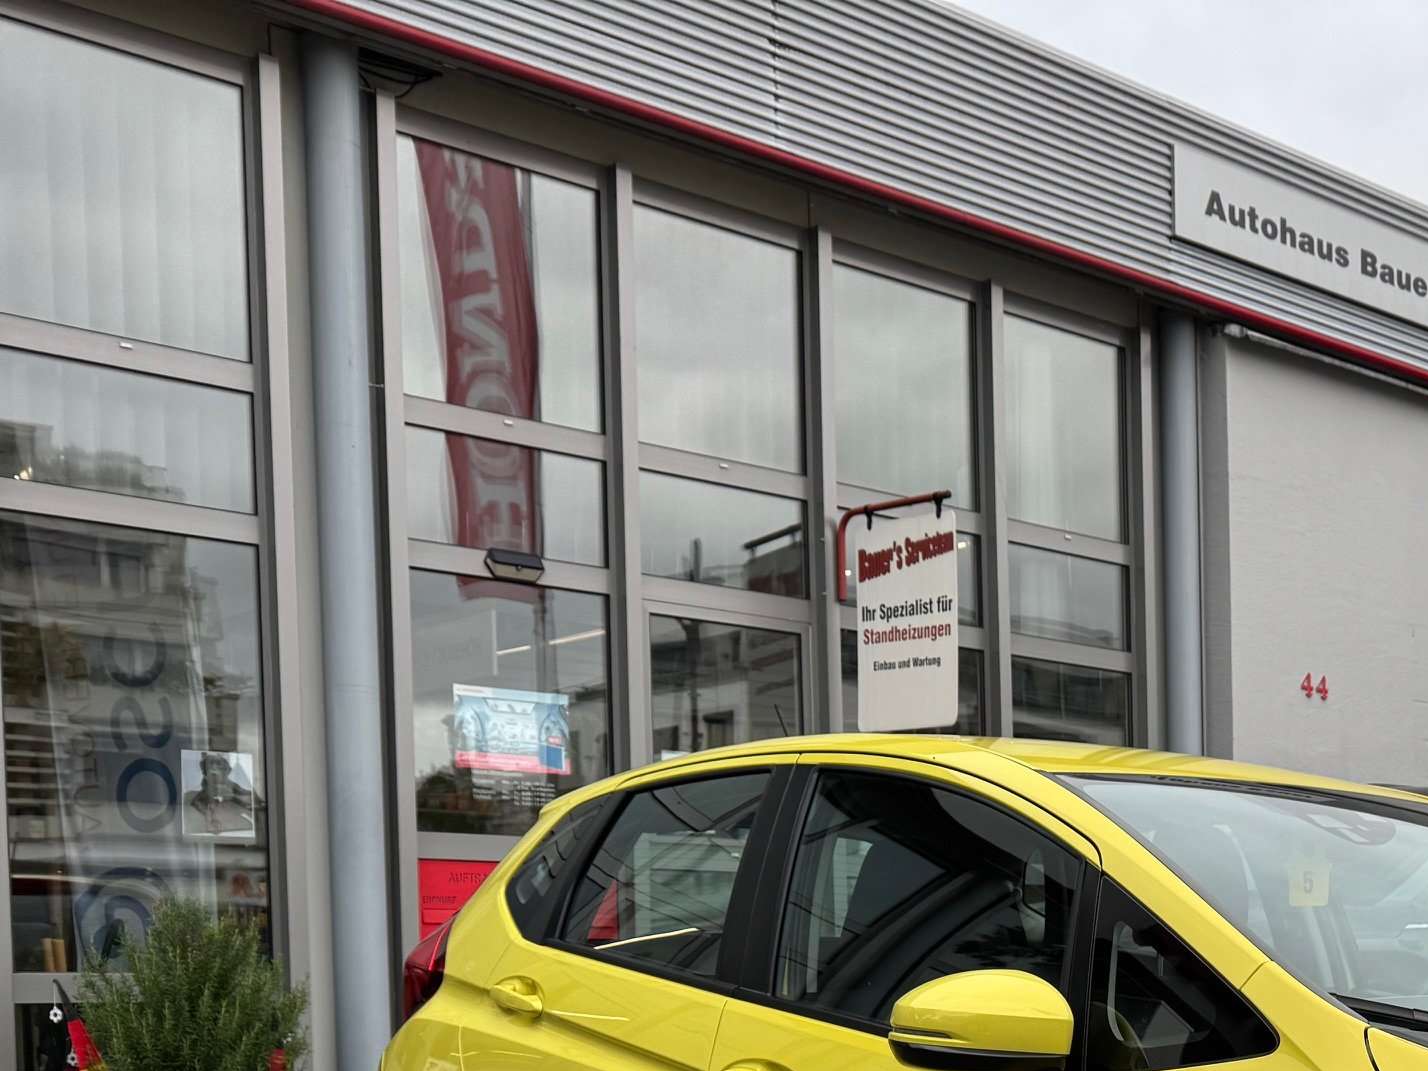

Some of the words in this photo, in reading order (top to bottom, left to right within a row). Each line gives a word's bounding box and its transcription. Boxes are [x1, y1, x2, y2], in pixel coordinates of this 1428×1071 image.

[1204, 190, 1350, 268] Autohaus
[857, 541, 903, 583] Bauer's
[862, 606, 876, 622] Ihr
[879, 597, 934, 623] Spezialist
[937, 595, 953, 613] für
[863, 623, 951, 645] Standheizungen
[873, 661, 897, 672] Einbau
[898, 659, 911, 670] und
[912, 656, 941, 670] Wartung
[1300, 672, 1329, 701] 44
[1303, 870, 1314, 894] 5
